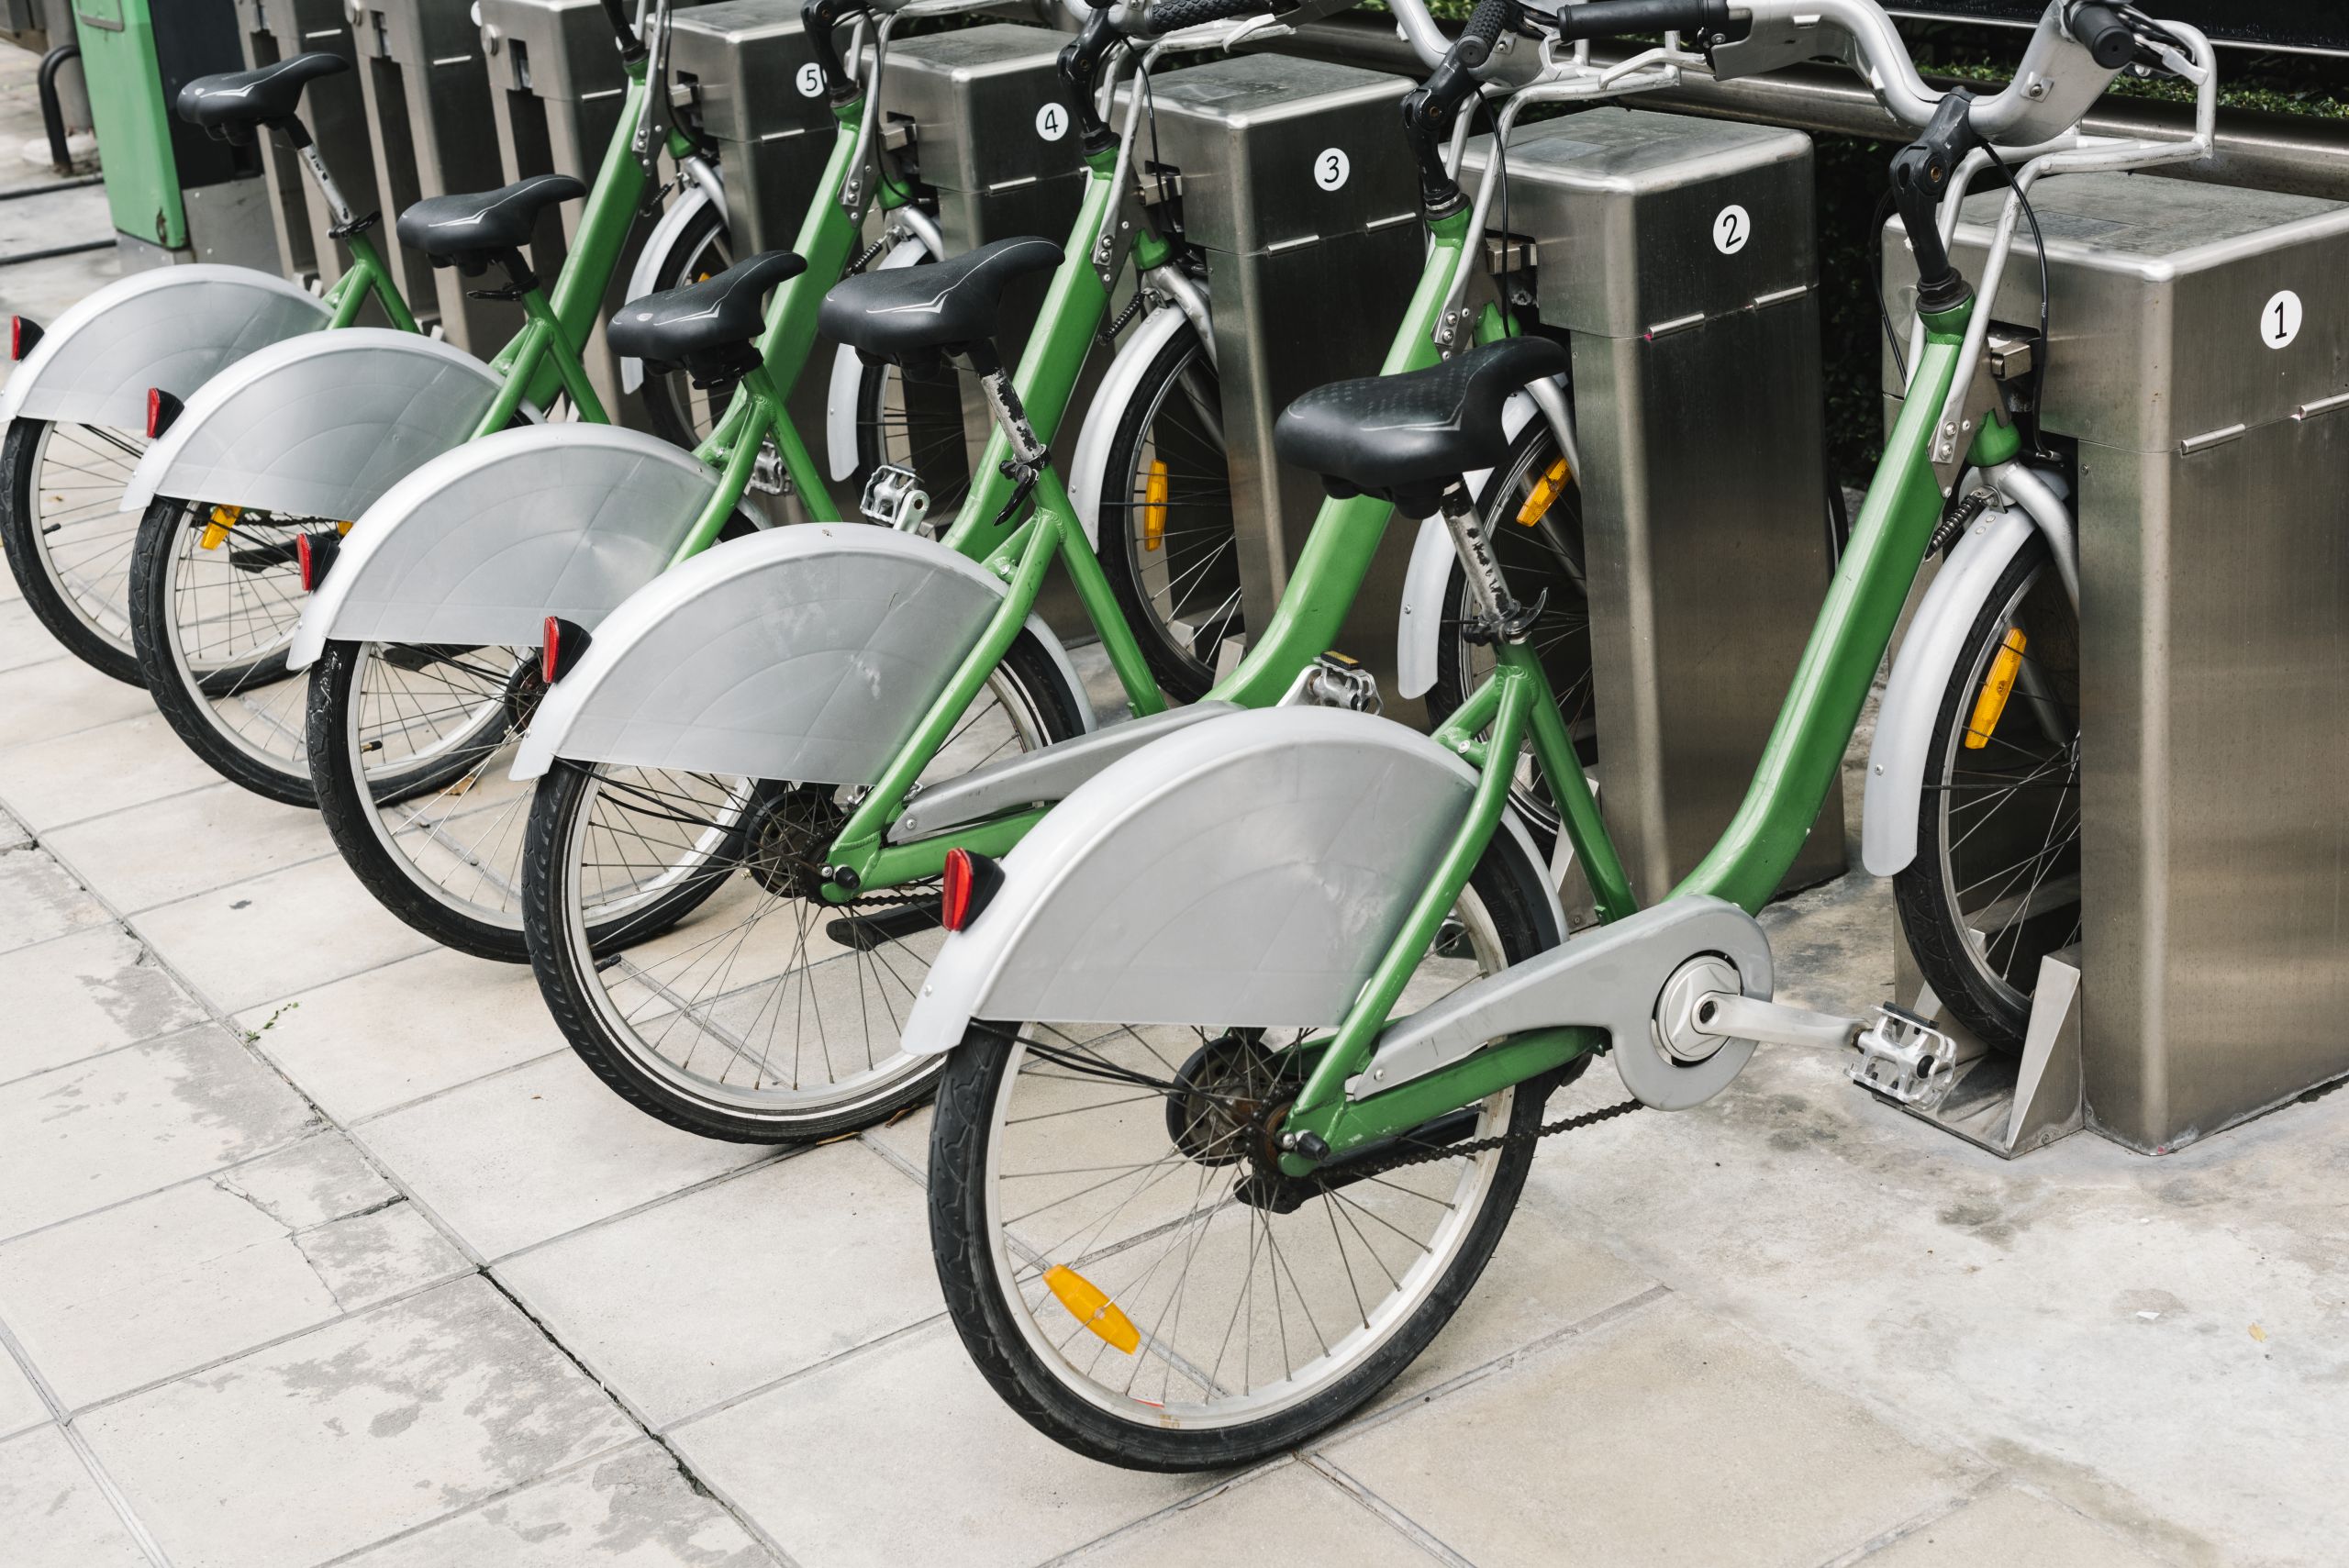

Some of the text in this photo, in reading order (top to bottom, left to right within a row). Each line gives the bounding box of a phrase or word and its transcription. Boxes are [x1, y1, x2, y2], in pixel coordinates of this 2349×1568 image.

[805, 70, 818, 92] 5
[1044, 109, 1059, 134] 4
[1323, 155, 1340, 183] 3
[1722, 213, 1742, 249] 2
[2274, 301, 2288, 340] 1
